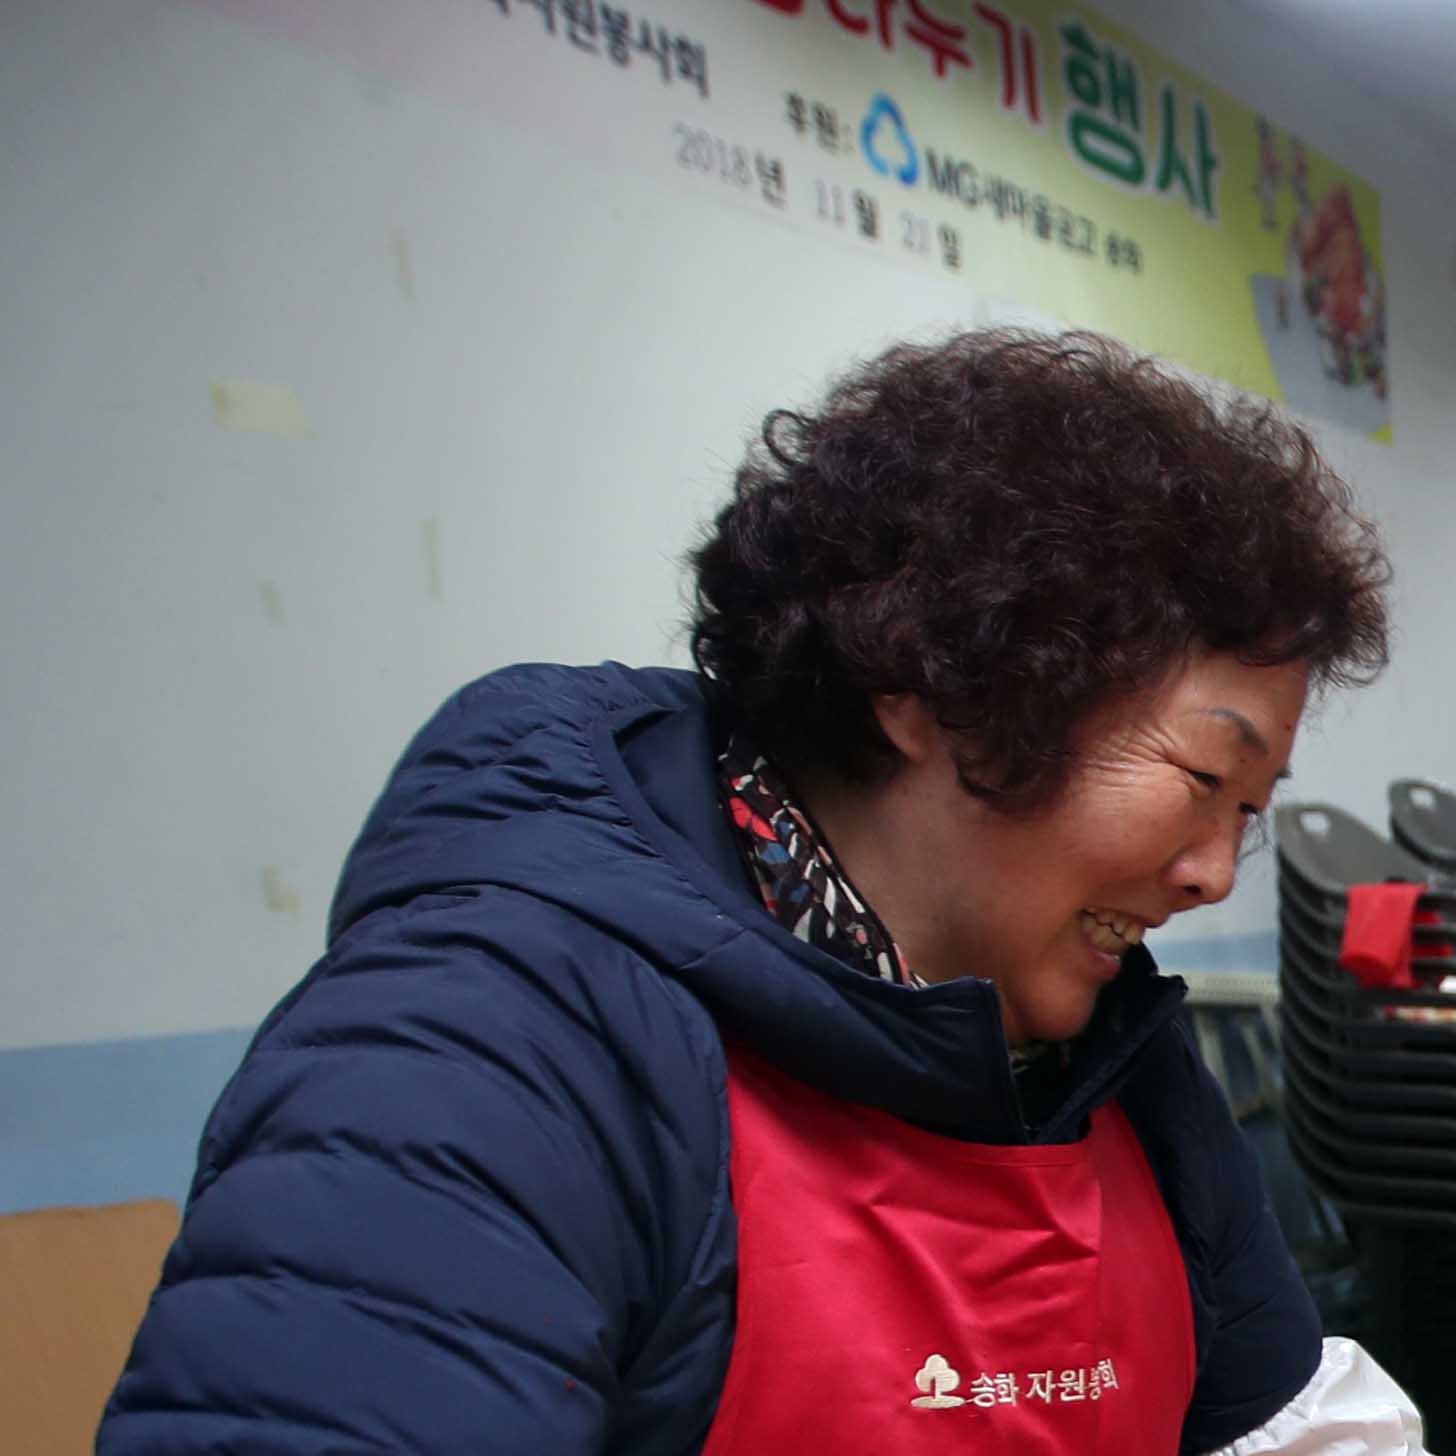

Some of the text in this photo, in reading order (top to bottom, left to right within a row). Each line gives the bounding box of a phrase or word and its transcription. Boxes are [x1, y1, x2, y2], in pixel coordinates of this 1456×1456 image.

[488, 0, 709, 99] 원봉사회
[752, 0, 1216, 219] 나누기 행사
